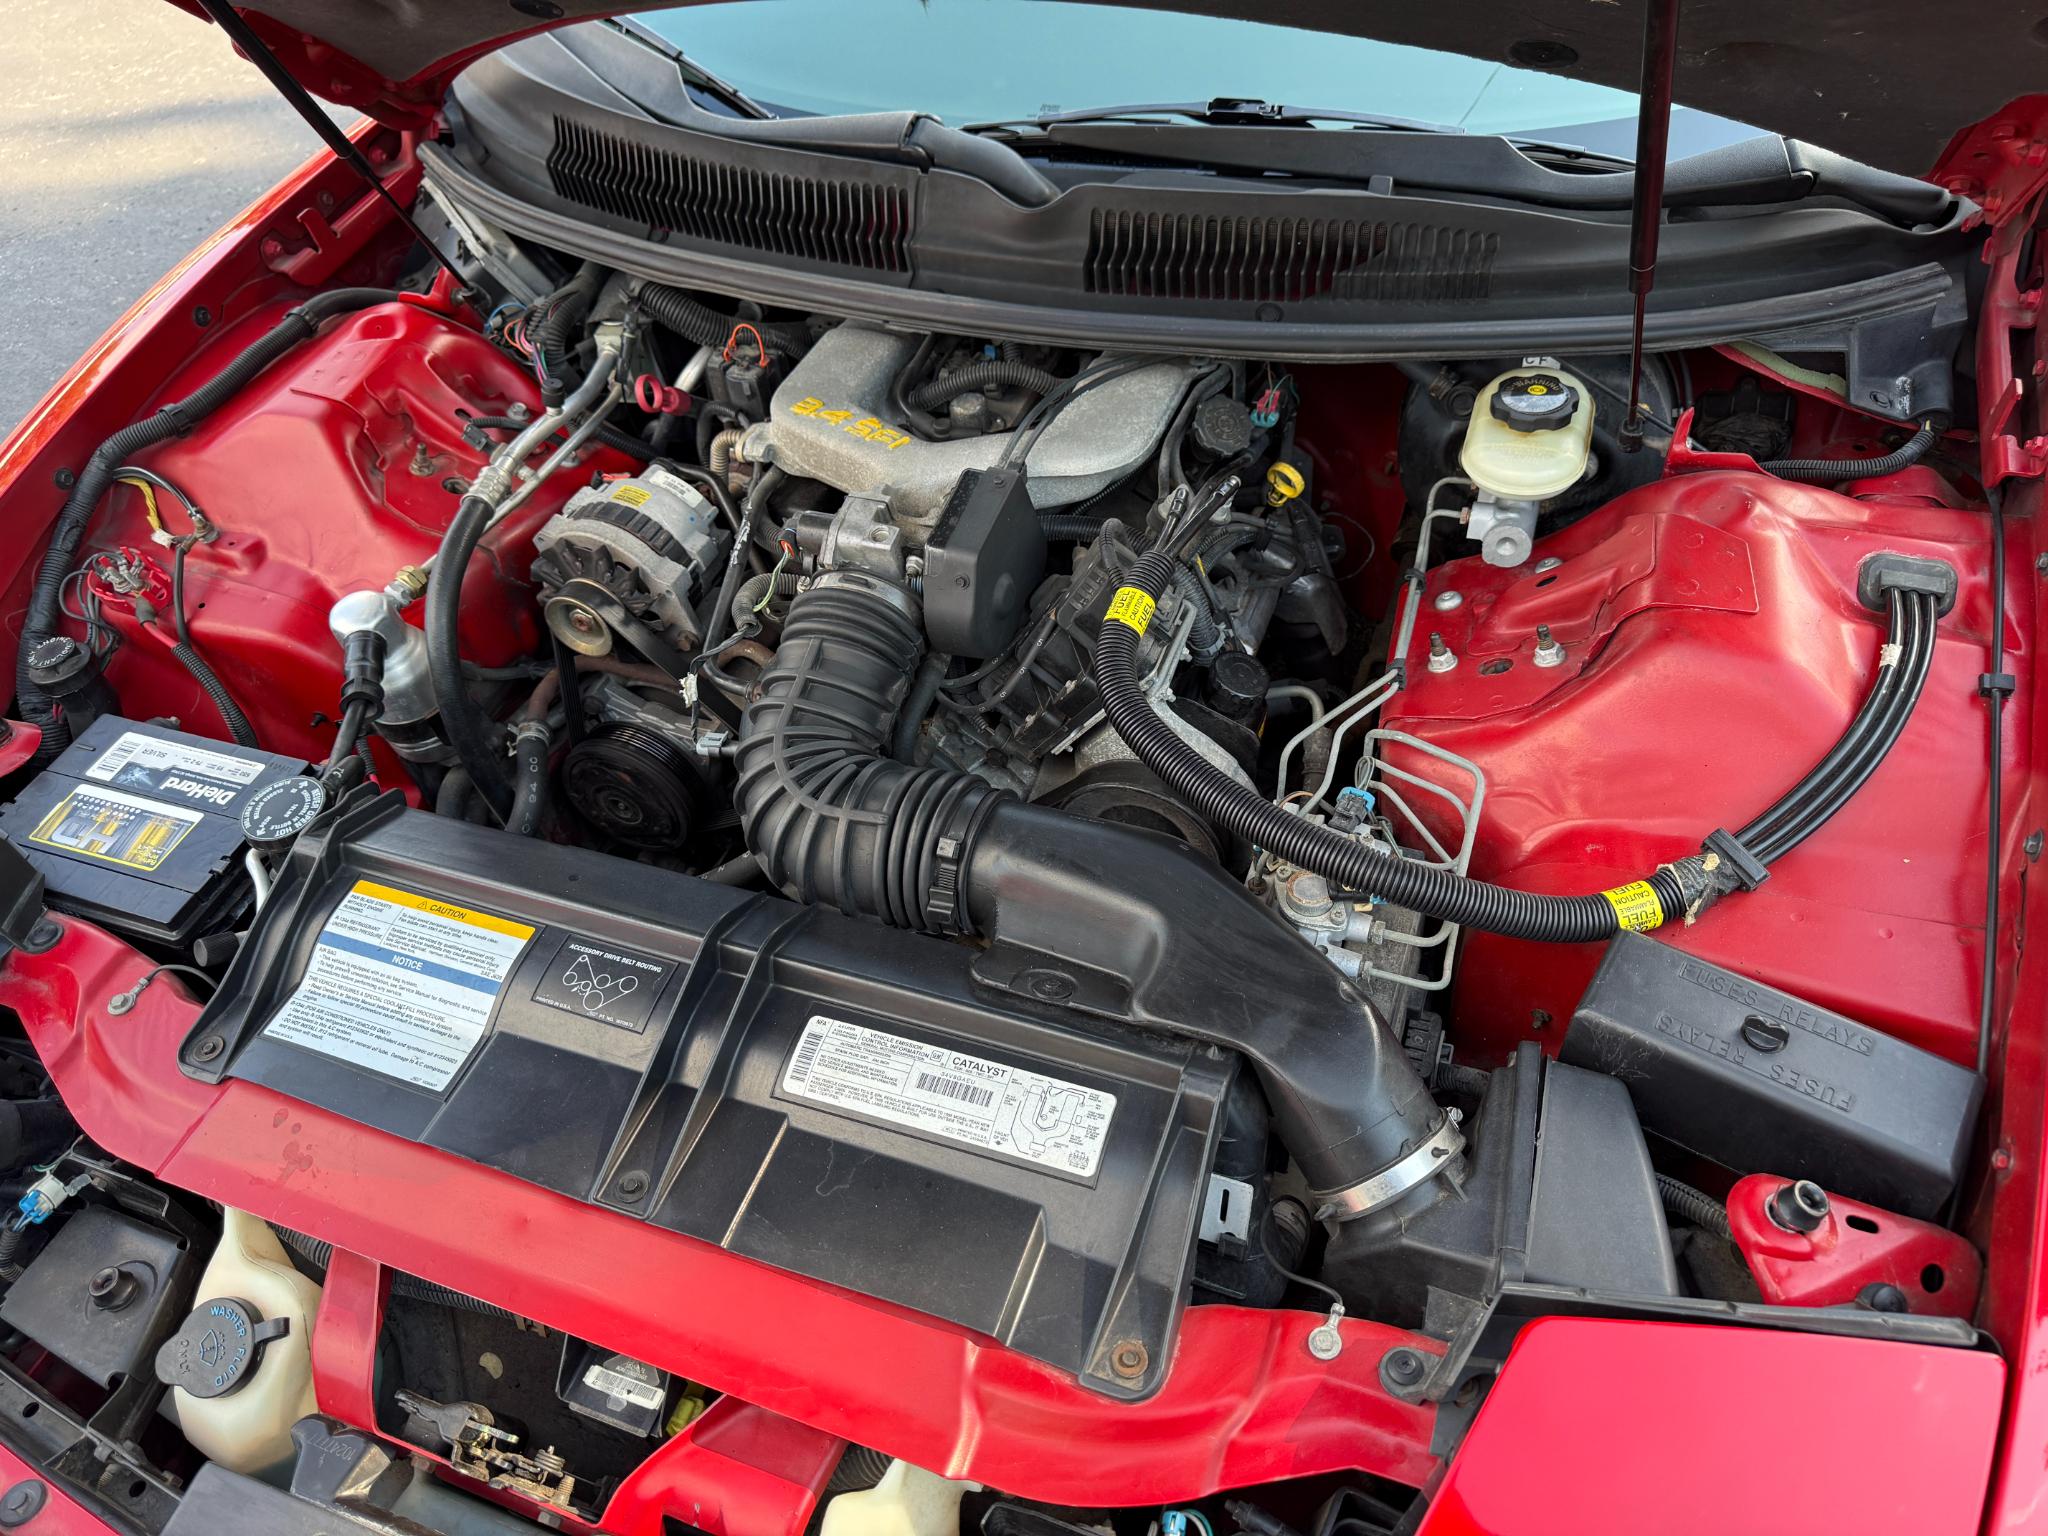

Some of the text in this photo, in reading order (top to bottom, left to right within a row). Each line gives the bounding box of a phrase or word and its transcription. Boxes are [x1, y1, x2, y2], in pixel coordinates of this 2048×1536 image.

[1114, 590, 1130, 614] FUEL
[1129, 593, 1145, 620] CAUTION
[1137, 602, 1152, 627] FUEL
[158, 776, 237, 806] DieHard
[294, 810, 316, 829] OPEN
[274, 826, 293, 838] HOT
[1614, 889, 1649, 905] CAUTION
[429, 903, 466, 919] CAUTION
[1622, 906, 1656, 924] FUEL
[391, 955, 422, 970] NOTICE
[569, 943, 661, 972] ACCESSORY DRIVE BELT ROUTING
[1681, 963, 1874, 1051] FUSES RELAYS
[861, 1036, 930, 1058] CONTROL INFORMATION
[869, 1032, 894, 1043] VEHICLE
[894, 1039, 923, 1051] EMISSION
[952, 1056, 1008, 1078] CATALYST
[1658, 1014, 1853, 1110] FUSES RELAYS
[210, 1306, 246, 1386] WASHER FLUID
